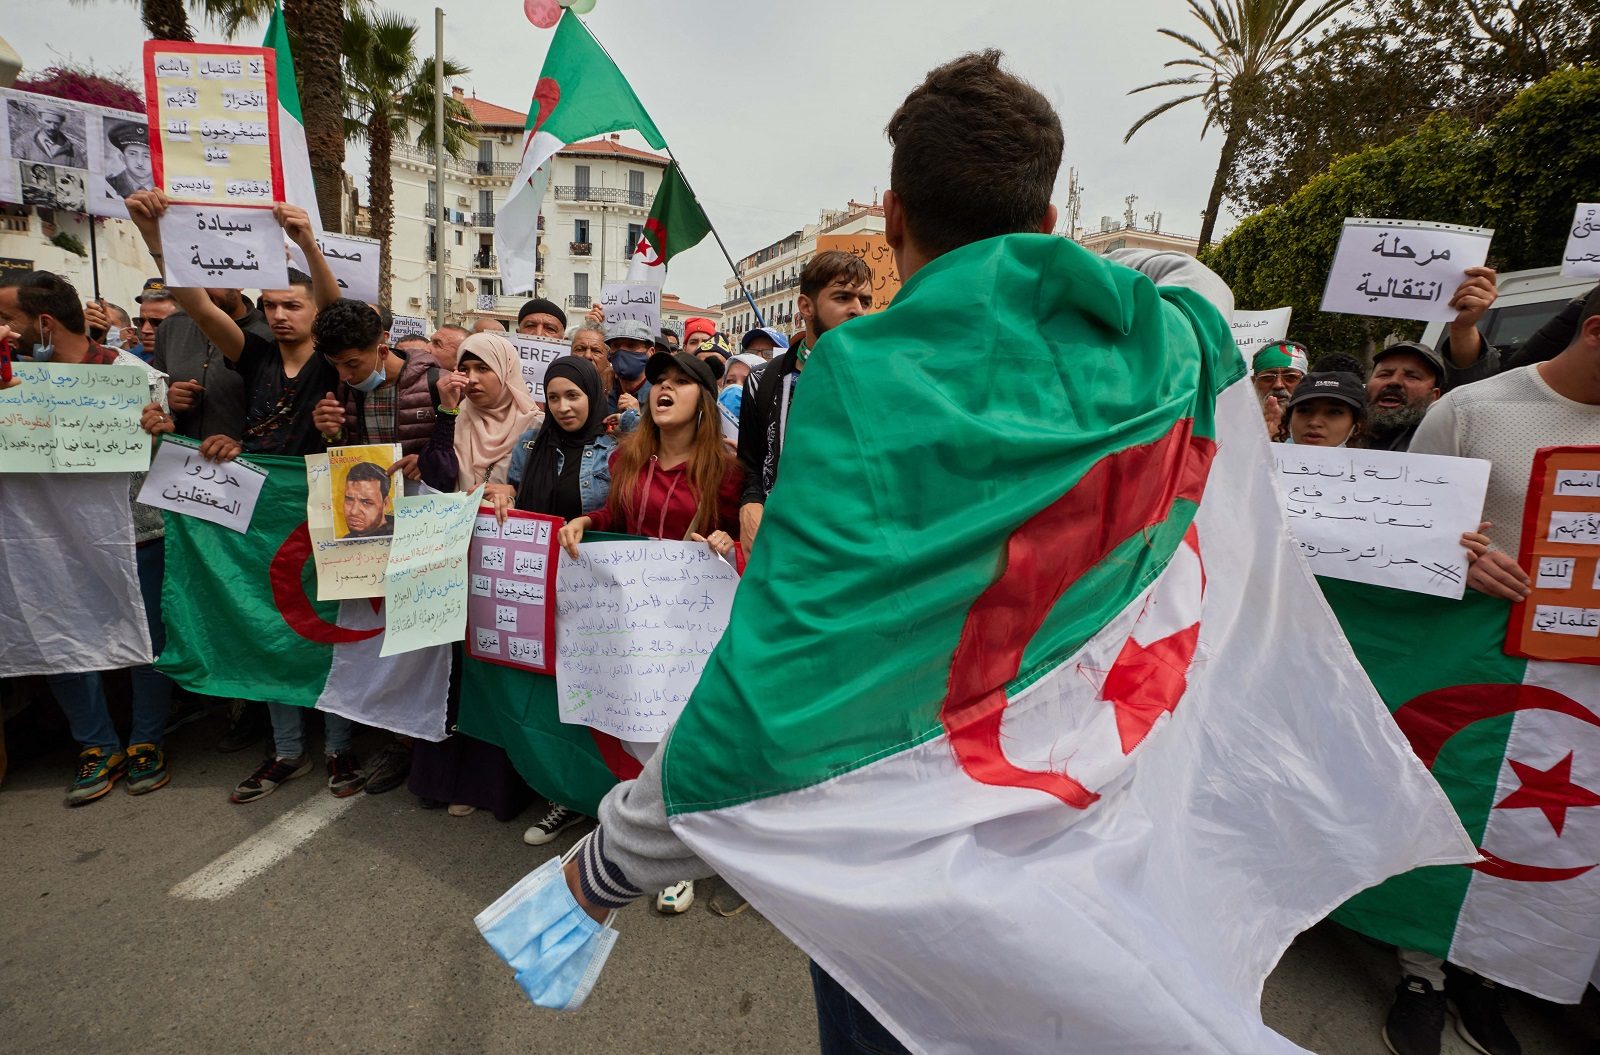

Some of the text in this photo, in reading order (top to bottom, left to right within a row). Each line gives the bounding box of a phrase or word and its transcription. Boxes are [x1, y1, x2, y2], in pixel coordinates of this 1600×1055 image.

[197, 212, 252, 236] سيادة
[191, 244, 259, 276] شعبية
[1372, 232, 1451, 266] مرحلة
[601, 289, 656, 305] الفصل بين
[1356, 272, 1442, 302] انتقالية
[184, 455, 240, 487] حرروا
[162, 484, 241, 516] المعتقلين
